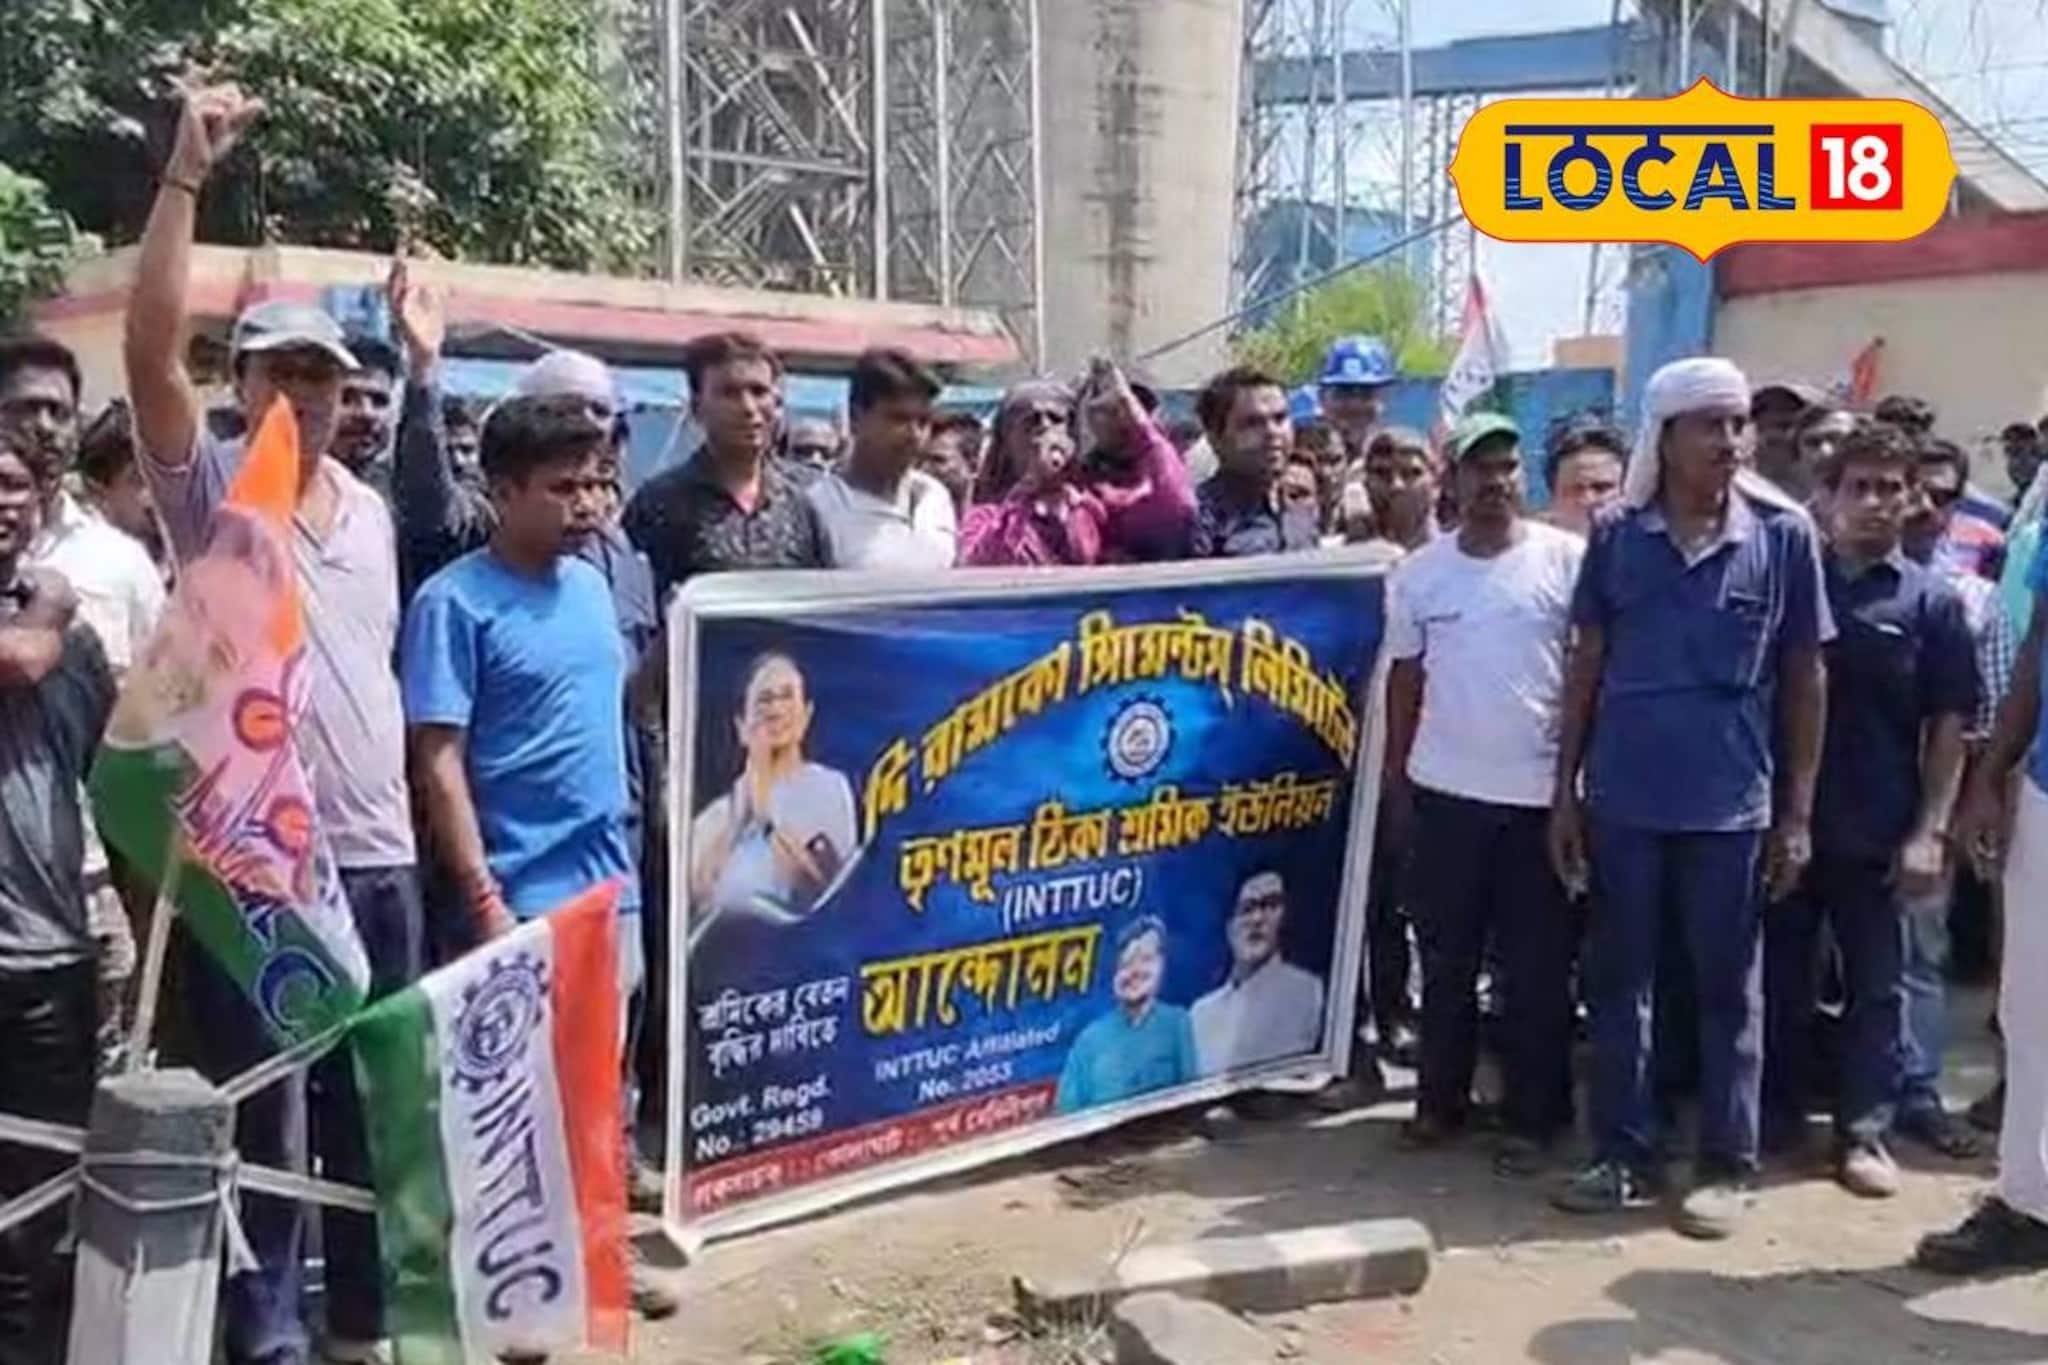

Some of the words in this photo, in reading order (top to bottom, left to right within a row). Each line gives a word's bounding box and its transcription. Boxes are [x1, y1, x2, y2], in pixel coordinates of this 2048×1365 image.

[899, 825, 1025, 913] তৃণমূল
[1028, 800, 1109, 869] ঠিকা
[1115, 785, 1214, 856] শ্রমিক
[1215, 772, 1337, 838] ইউনিয়ন
[1003, 866, 1143, 932] (INTTUC)
[859, 923, 1103, 1036] আন্দোলন
[874, 1042, 961, 1082] INTTUC
[689, 1094, 756, 1130] Govt.
[471, 1076, 563, 1322] INTTUC
